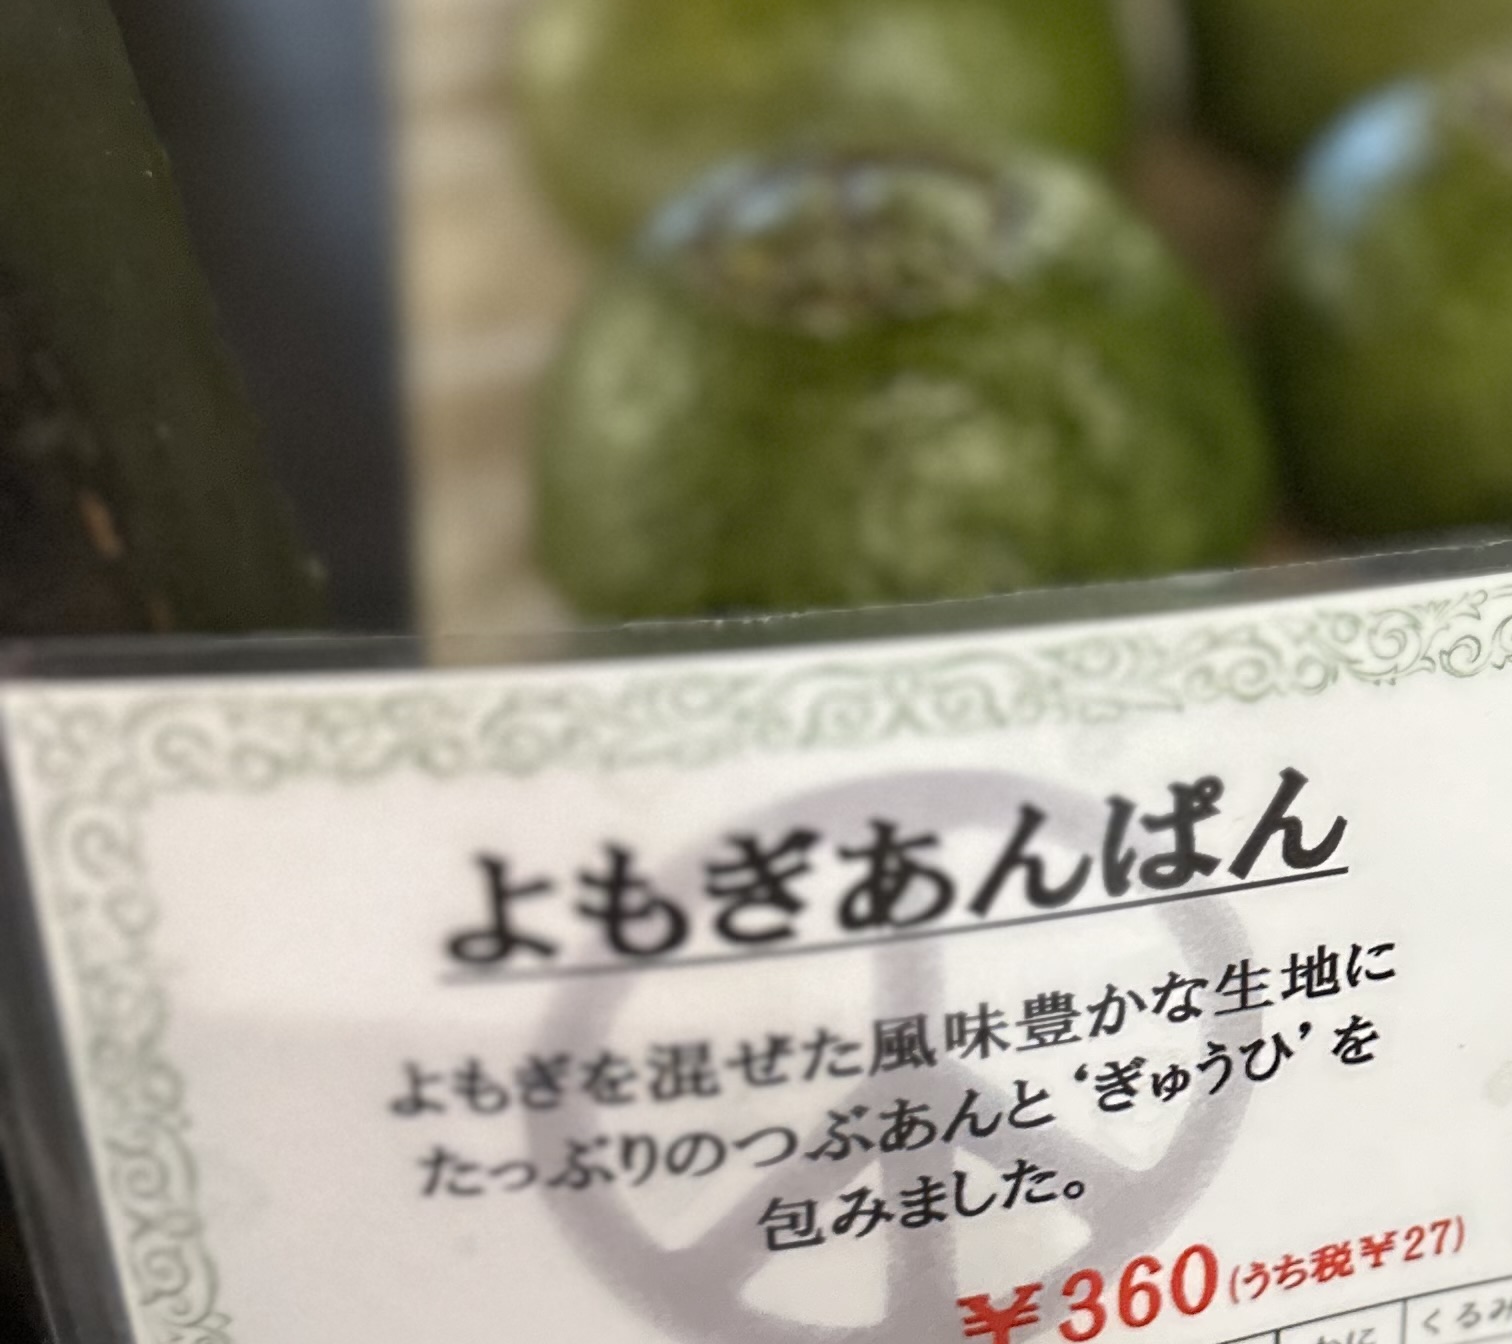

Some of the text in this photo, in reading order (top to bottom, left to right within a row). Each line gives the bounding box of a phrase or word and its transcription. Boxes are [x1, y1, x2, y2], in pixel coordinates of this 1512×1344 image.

[442, 765, 1348, 962] よもぎあんぱん
[386, 938, 1396, 1119] よもぎを混ぜた風味豊かな生地に
[756, 1157, 1086, 1252] 包みました。
